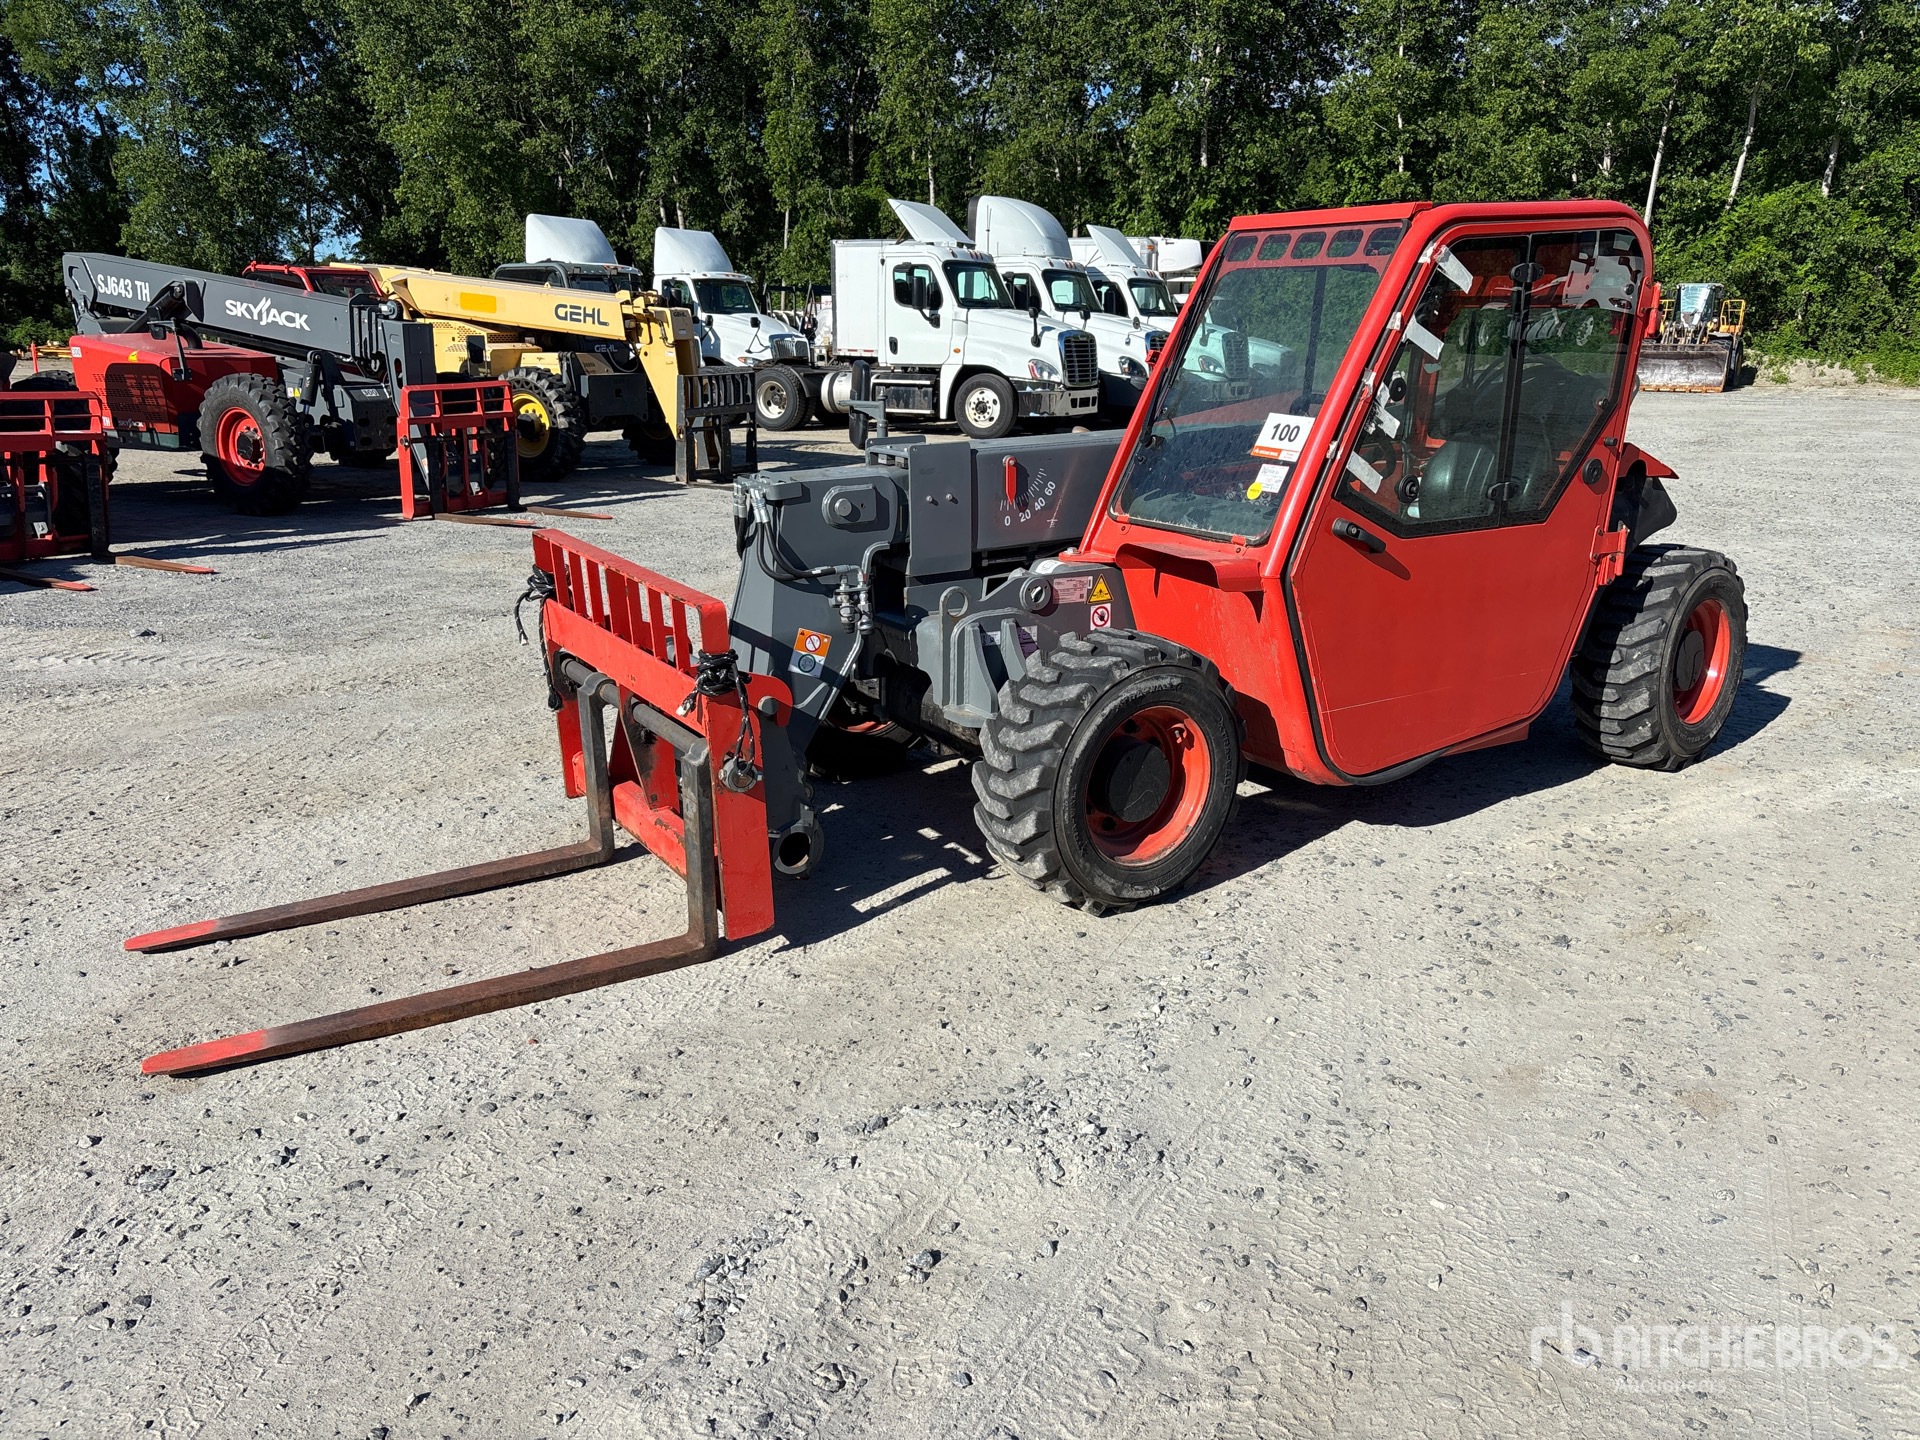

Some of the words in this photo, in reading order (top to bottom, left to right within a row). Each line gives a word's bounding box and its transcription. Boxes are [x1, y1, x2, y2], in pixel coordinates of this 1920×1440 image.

[97, 273, 133, 299] SJ643
[135, 280, 150, 303] TH
[225, 297, 311, 332] SKYJACK
[554, 303, 610, 327] GEHL
[594, 344, 618, 353] GEHL
[1271, 423, 1301, 442] 100
[1004, 515, 1011, 526] 0
[1019, 509, 1031, 522] 20
[1034, 497, 1046, 511] 40
[1044, 481, 1056, 496] 60
